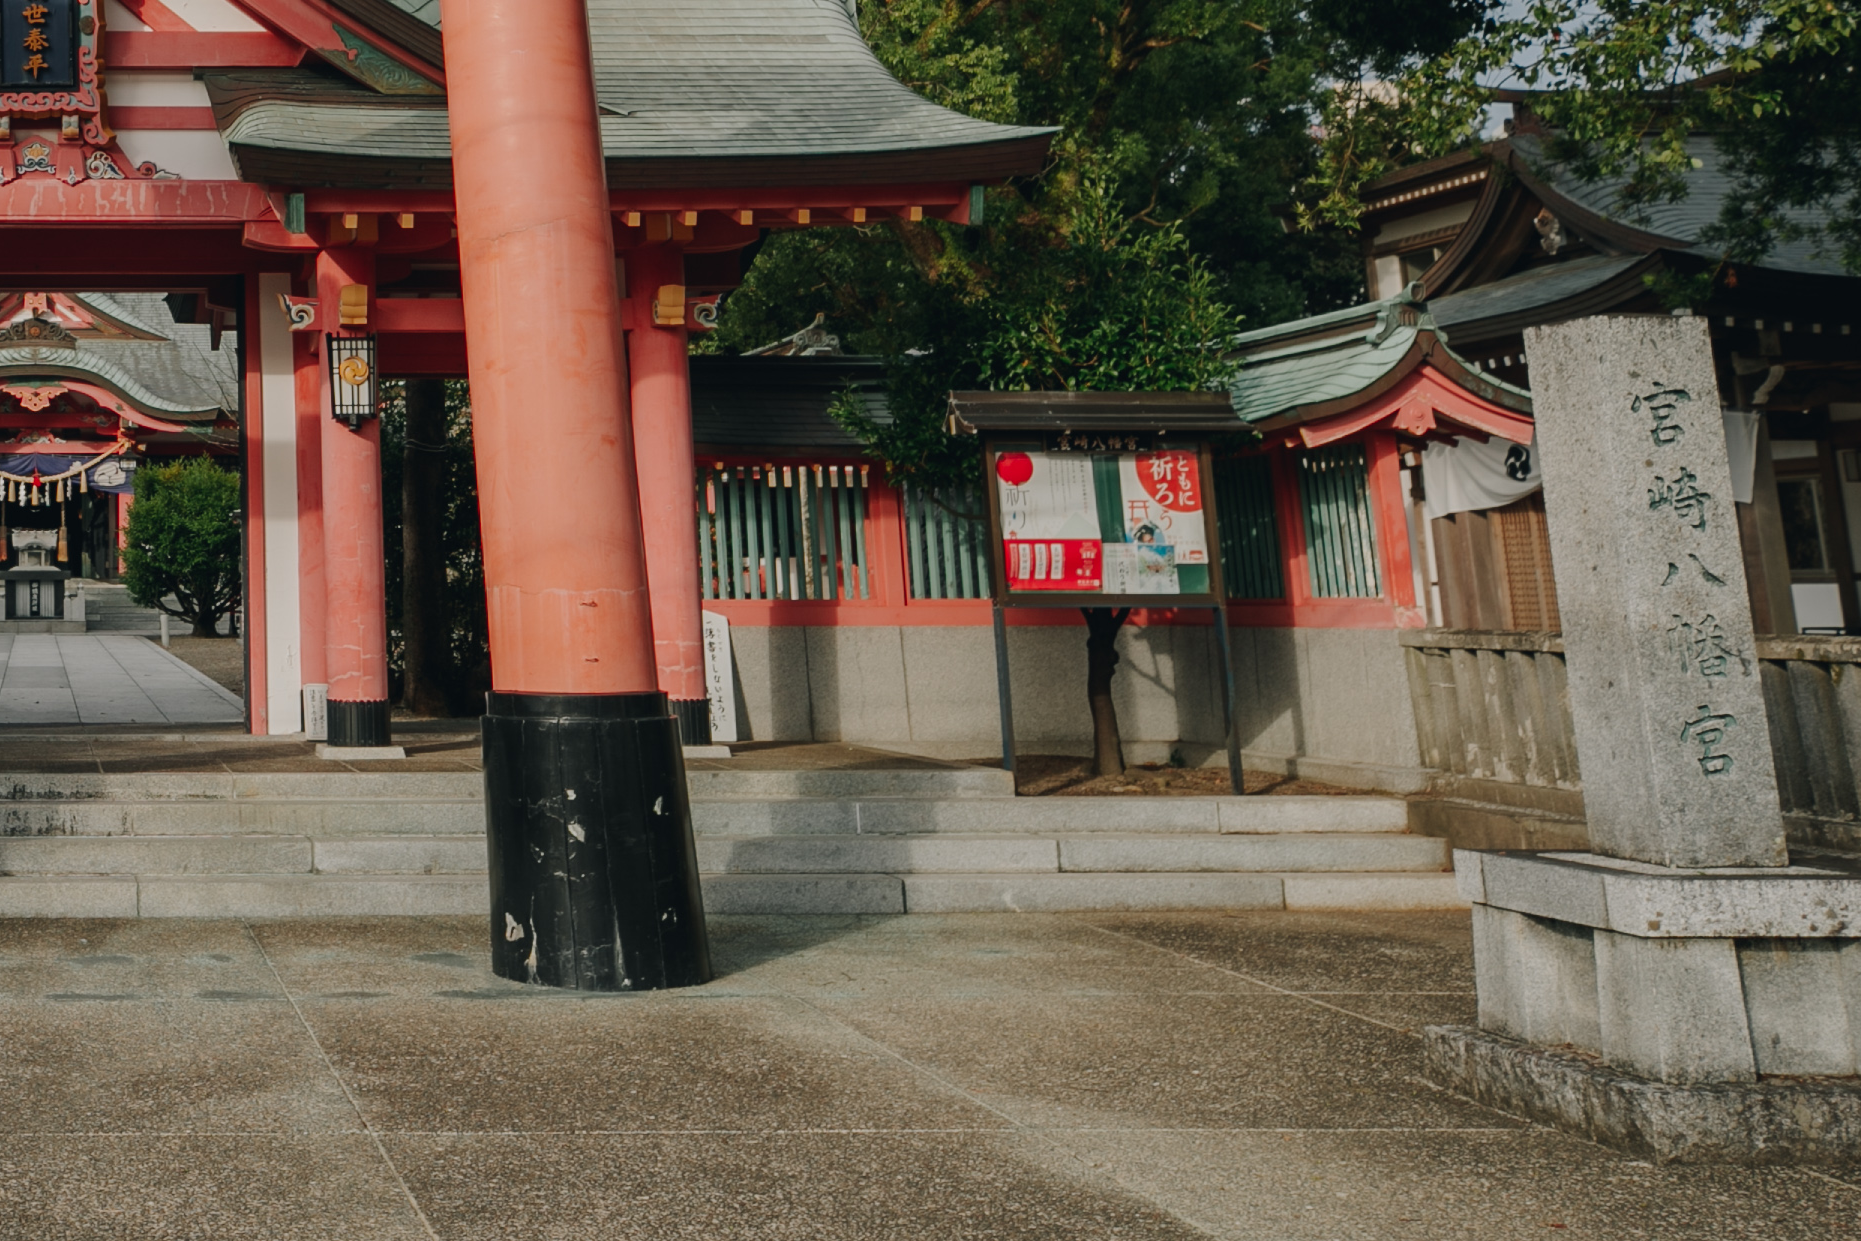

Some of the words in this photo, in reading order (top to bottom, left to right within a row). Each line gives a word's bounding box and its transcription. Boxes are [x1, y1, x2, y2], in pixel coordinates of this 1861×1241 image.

[1057, 435, 1139, 450] 宮崎八幡宮
[1149, 456, 1174, 531] 祈ろう
[1177, 455, 1196, 506] ともに
[1631, 381, 1741, 780] 宮崎八幡宮
